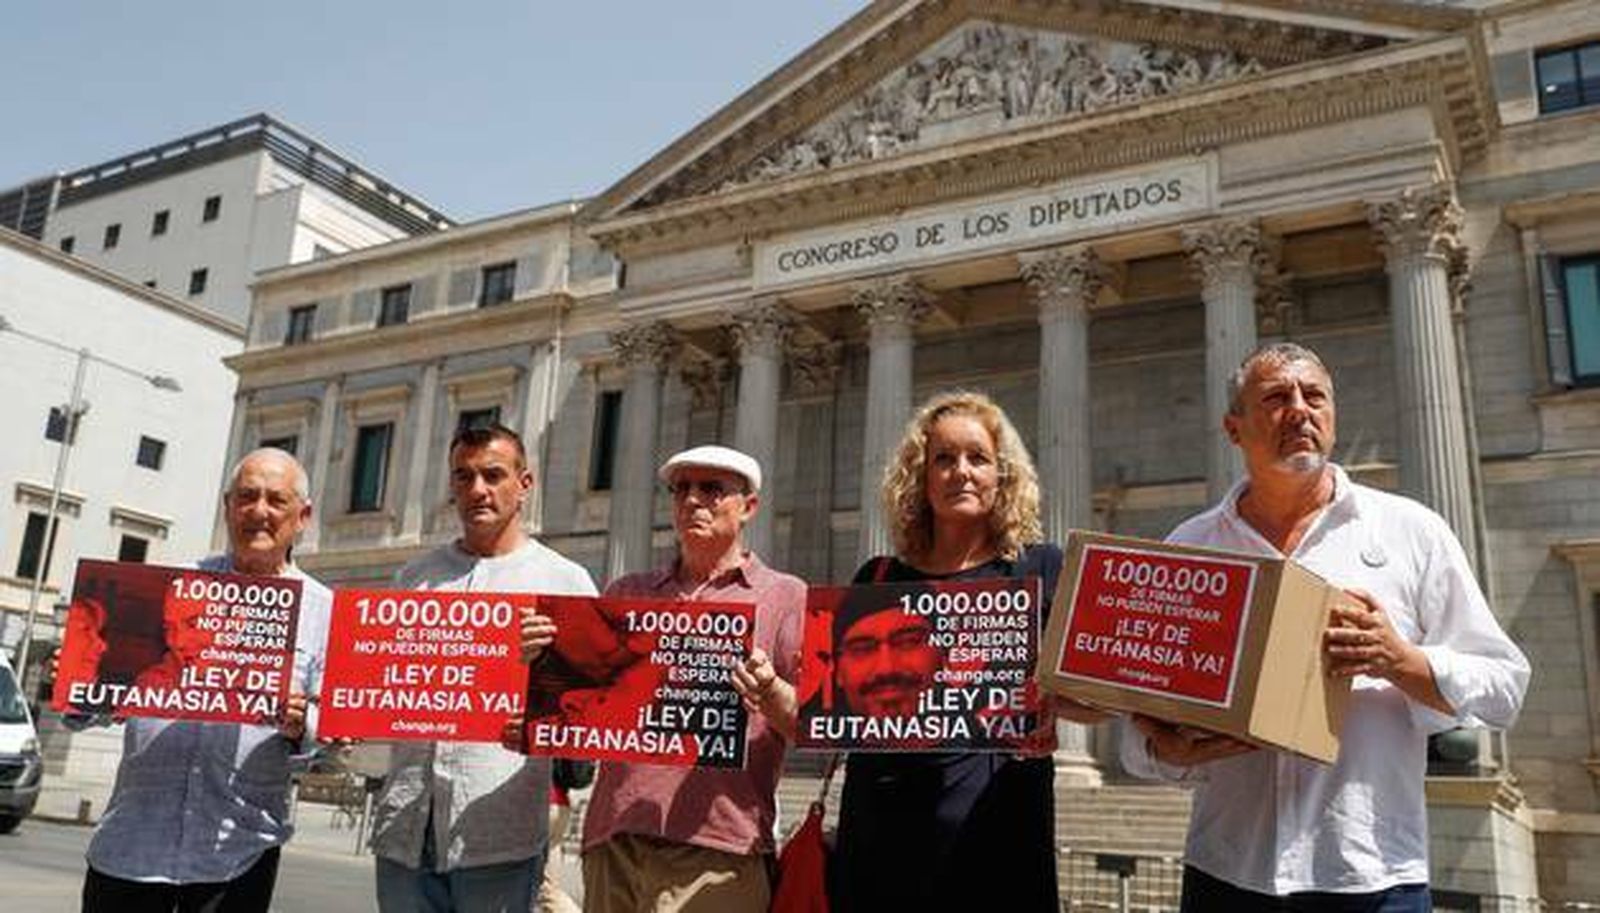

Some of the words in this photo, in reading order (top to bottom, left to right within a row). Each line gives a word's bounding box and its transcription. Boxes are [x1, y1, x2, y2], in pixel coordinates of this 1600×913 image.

[777, 232, 899, 272] CONGRESO
[915, 223, 946, 249] DE
[963, 212, 1009, 239] LOS
[1028, 179, 1182, 227] DIPUTADOS
[1103, 559, 1227, 597] 1.000.000
[172, 578, 294, 607] 1.000.000
[1130, 588, 1145, 599] DE
[1149, 591, 1193, 605] FIRMAS
[900, 590, 1030, 616] 1.000.000
[1097, 595, 1114, 606] NO
[1116, 597, 1162, 615] PUEDEN
[1164, 604, 1221, 622] ESPERAR
[206, 605, 226, 617] DE
[231, 606, 290, 621] FIRMAS
[356, 600, 512, 628] 1.000.000
[937, 618, 958, 631] DE
[964, 614, 1028, 630] FIRMAS
[197, 618, 221, 631] NO
[225, 619, 289, 636] PUEDEN
[626, 611, 747, 636] 1.000.000
[1116, 618, 1159, 638] ¡LEY
[1163, 624, 1191, 645] DE
[214, 633, 286, 650] ESPERAR
[396, 630, 414, 640] DE
[419, 630, 474, 642] FIRMAS
[659, 635, 680, 648] DE
[684, 636, 744, 652] FIRMAS
[929, 633, 953, 647] NO
[958, 631, 1028, 647] PUEDEN
[201, 650, 283, 667] change.org
[354, 642, 375, 654] NO
[379, 643, 438, 655] PUEDEN
[442, 644, 508, 656] ESPERAR
[651, 652, 674, 664] NO
[950, 648, 1028, 662] ESPERAR
[1075, 633, 1184, 667] EUTANASIA
[1191, 652, 1225, 674] YA!
[181, 666, 240, 688] ¡LEY
[247, 671, 281, 691] DE
[384, 666, 437, 685] ¡LEY
[443, 666, 476, 685] DE
[669, 668, 735, 683] ESPERA
[934, 668, 1025, 683] change.org
[69, 683, 228, 712] EUTANASIA
[237, 693, 278, 716] YA!
[332, 689, 472, 711] EUTANASIA
[480, 693, 520, 713] YA!
[655, 686, 739, 705] change.org
[919, 688, 980, 713] ¡LEY
[989, 688, 1025, 710] DE
[391, 720, 456, 734] change.org
[638, 706, 696, 729] ¡LEY
[703, 708, 736, 731] DE
[811, 716, 970, 739] EUTANASIA
[978, 717, 1025, 737] YA!
[535, 724, 685, 754] EUTANASIA
[694, 734, 735, 758] YA!
